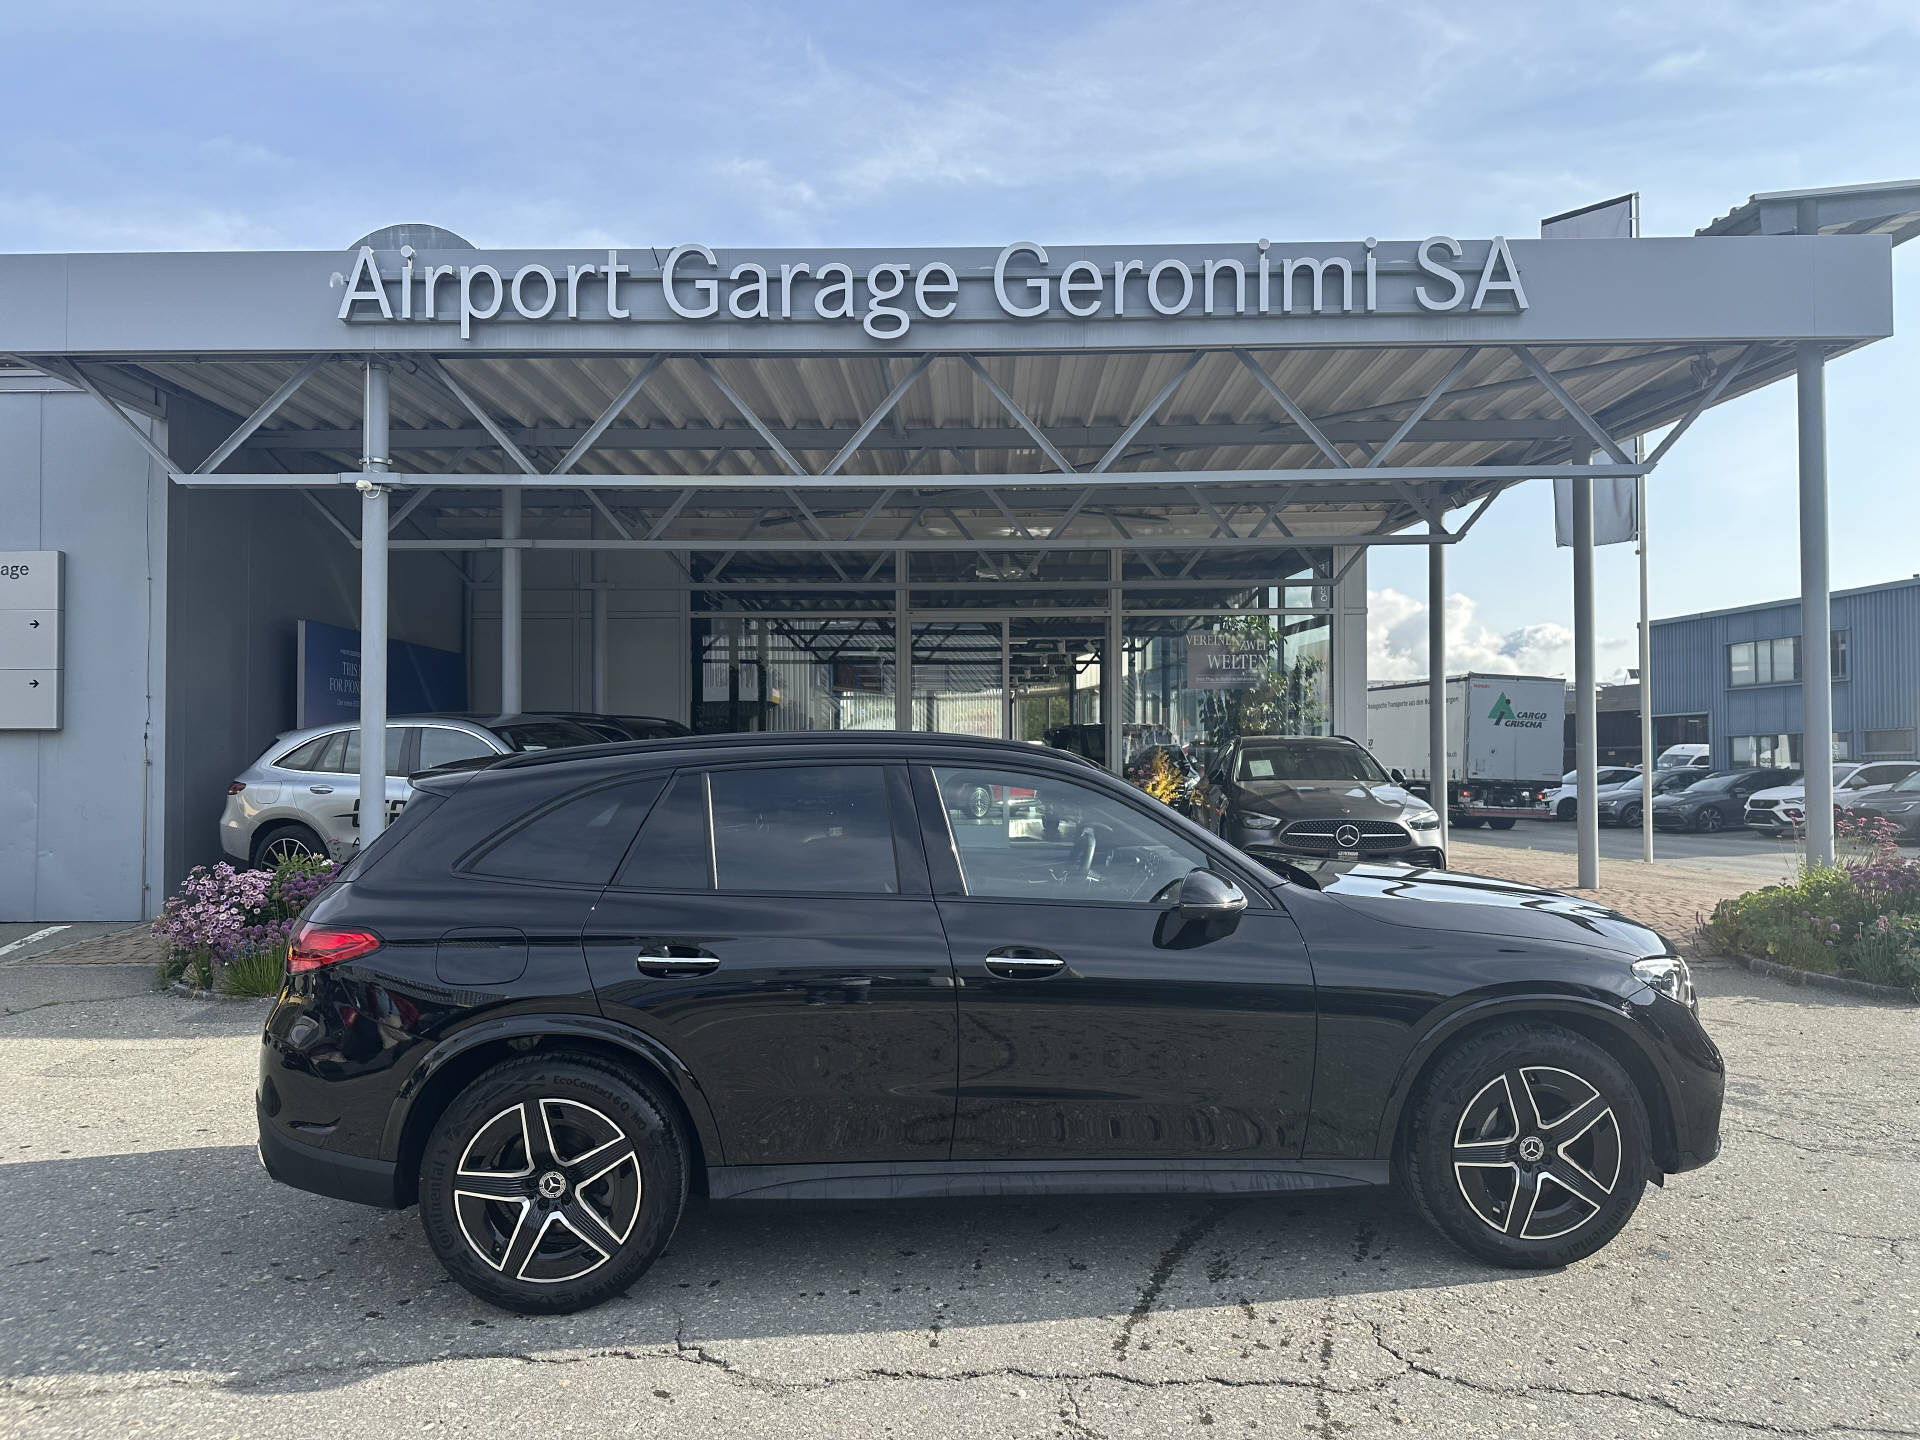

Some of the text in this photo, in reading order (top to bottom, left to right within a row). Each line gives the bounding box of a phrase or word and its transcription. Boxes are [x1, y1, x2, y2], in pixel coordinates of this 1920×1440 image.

[337, 235, 1529, 339] Airport Garage Geronimi SA
[0, 565, 29, 579] age
[1240, 640, 1268, 651] ZWEI
[1207, 654, 1268, 670] WELTEN
[329, 677, 360, 694] FOR PION
[1516, 711, 1547, 720] CARGO
[1504, 720, 1543, 729] GRISCHA
[553, 1075, 613, 1099] EcoContact
